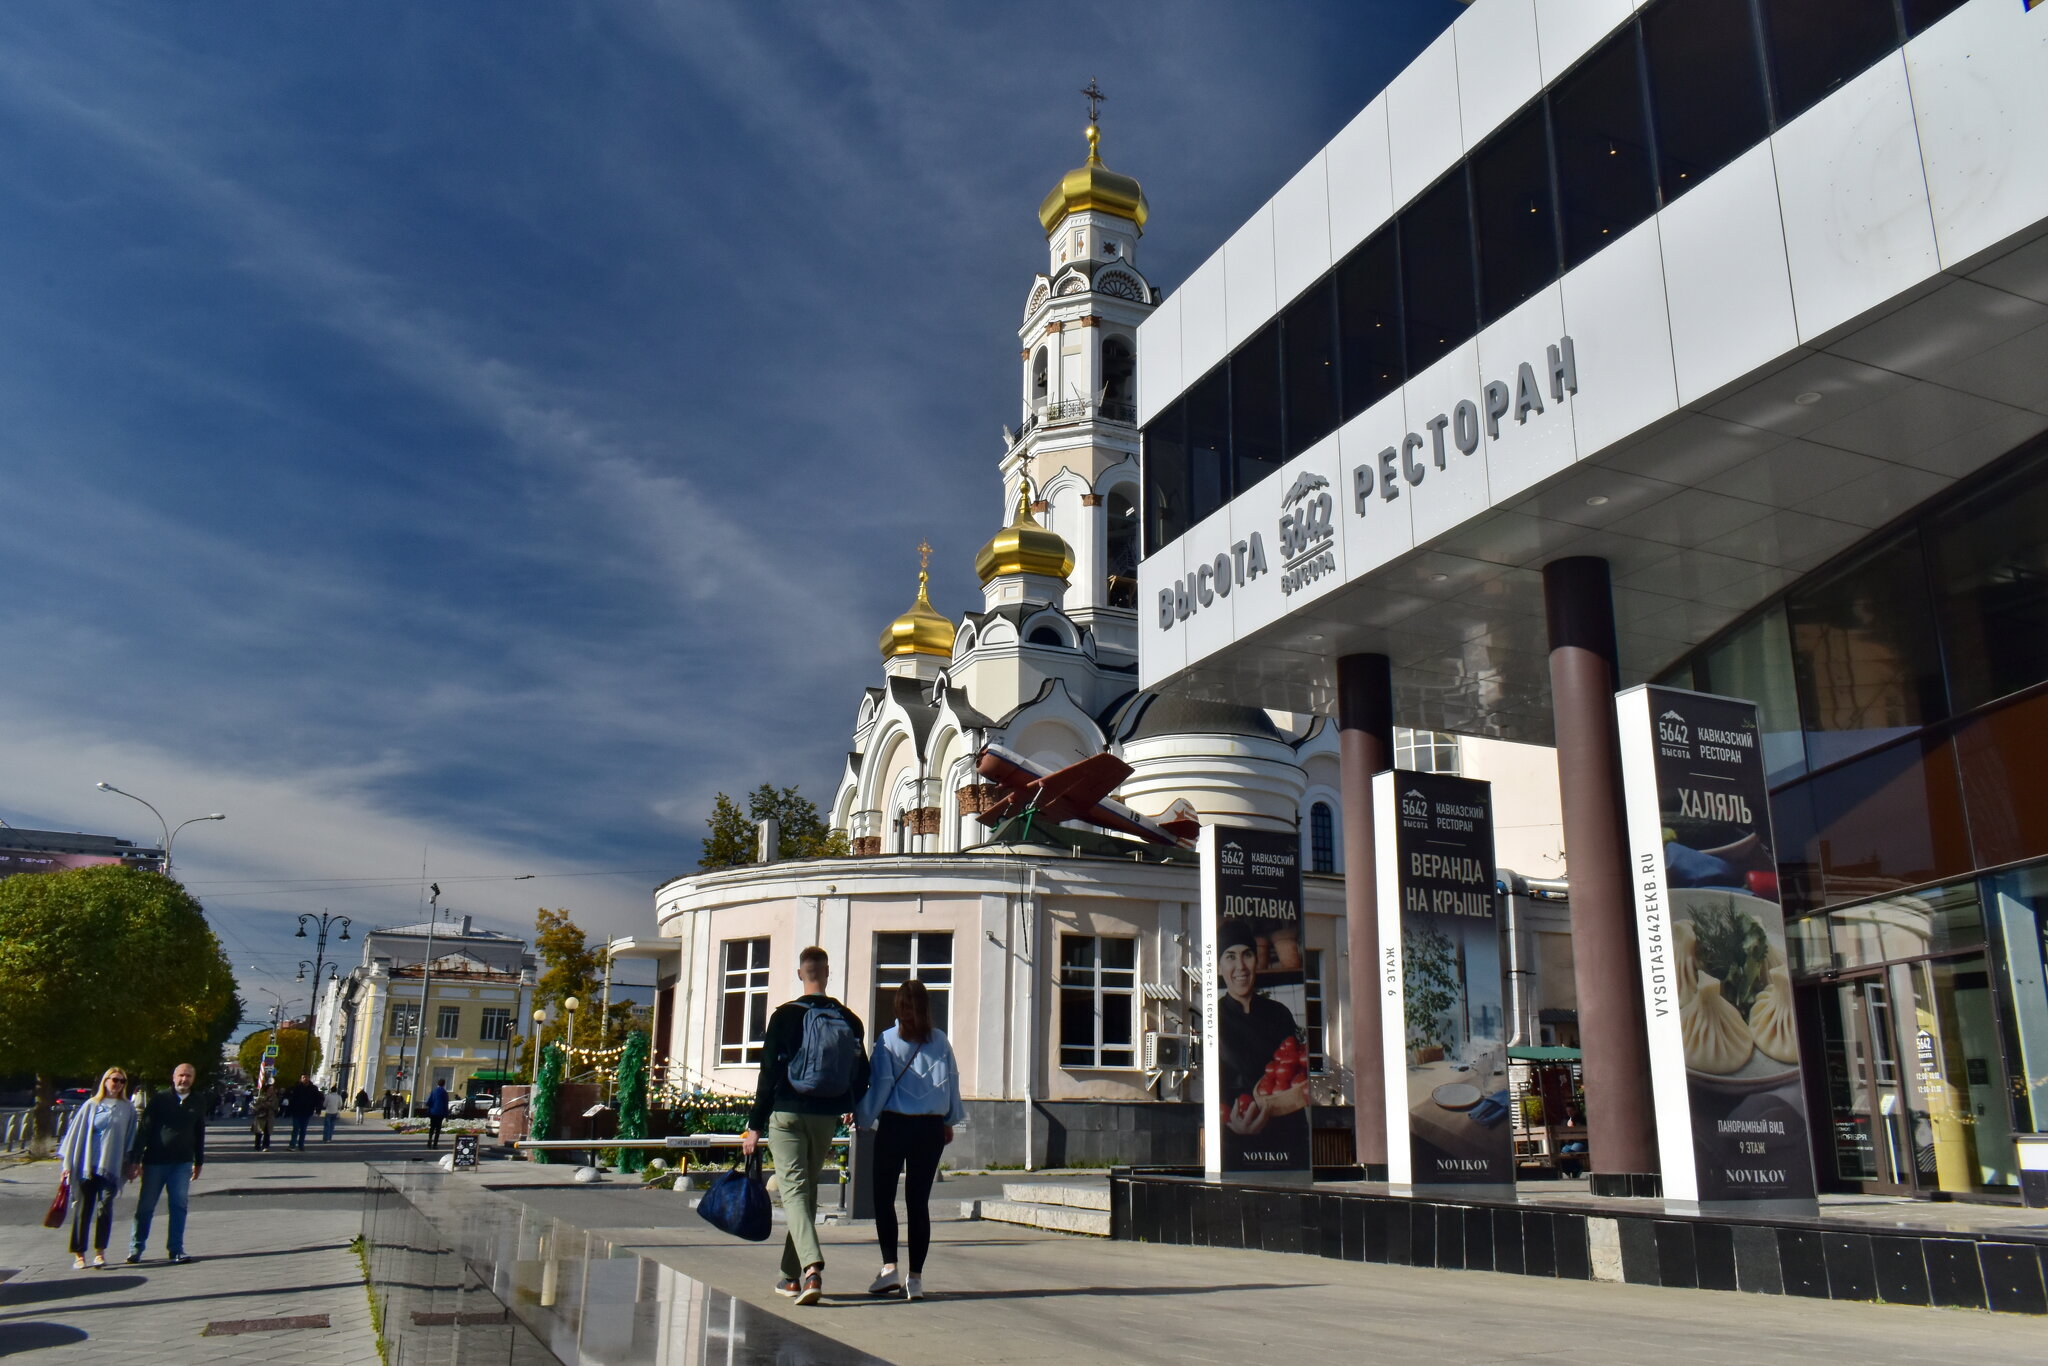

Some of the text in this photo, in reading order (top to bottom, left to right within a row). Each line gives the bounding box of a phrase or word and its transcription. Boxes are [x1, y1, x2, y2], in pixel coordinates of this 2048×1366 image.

[1353, 336, 1577, 518] РЕСТОРАН
[1279, 492, 1334, 560] 5642
[1158, 531, 1268, 631] ВЫСОТА
[1659, 722, 1689, 743] 5642
[1698, 727, 1753, 748] КАВКАЗСКИЙ
[1662, 747, 1691, 759] ВЫСОТА
[1700, 745, 1742, 763] РЕСТОРАН
[1402, 800, 1428, 817] 5642
[1436, 803, 1484, 819] КАВКАЗСКИЙ
[1678, 788, 1753, 824] ХАЛЯЛЬ
[1129, 810, 1141, 822] 15
[1403, 820, 1428, 829] ВЫСОТА
[1437, 817, 1473, 832] РЕСТОРАН
[1221, 850, 1244, 865] 5642
[1251, 852, 1295, 866] КАВКАЗСКИЙ
[1252, 865, 1284, 877] РЕСТОРАН
[1411, 852, 1484, 884] ВЕРАНДА
[1224, 895, 1296, 920] ДОСТАВКА
[1406, 887, 1492, 917] НА КРЫШЕ
[1641, 853, 1669, 1018] VYSOTA5642EKB.RU
[1386, 947, 1396, 983] ЭТАЖ
[1717, 1119, 1785, 1135] ПАНОРАМНЫЙ ВИД
[1740, 1141, 1766, 1154] 9 ЭТАЖ
[1242, 1152, 1290, 1161] NOVIKOV
[1436, 1159, 1490, 1170] NOVIKOV
[1726, 1169, 1786, 1183] NOVIKOV
